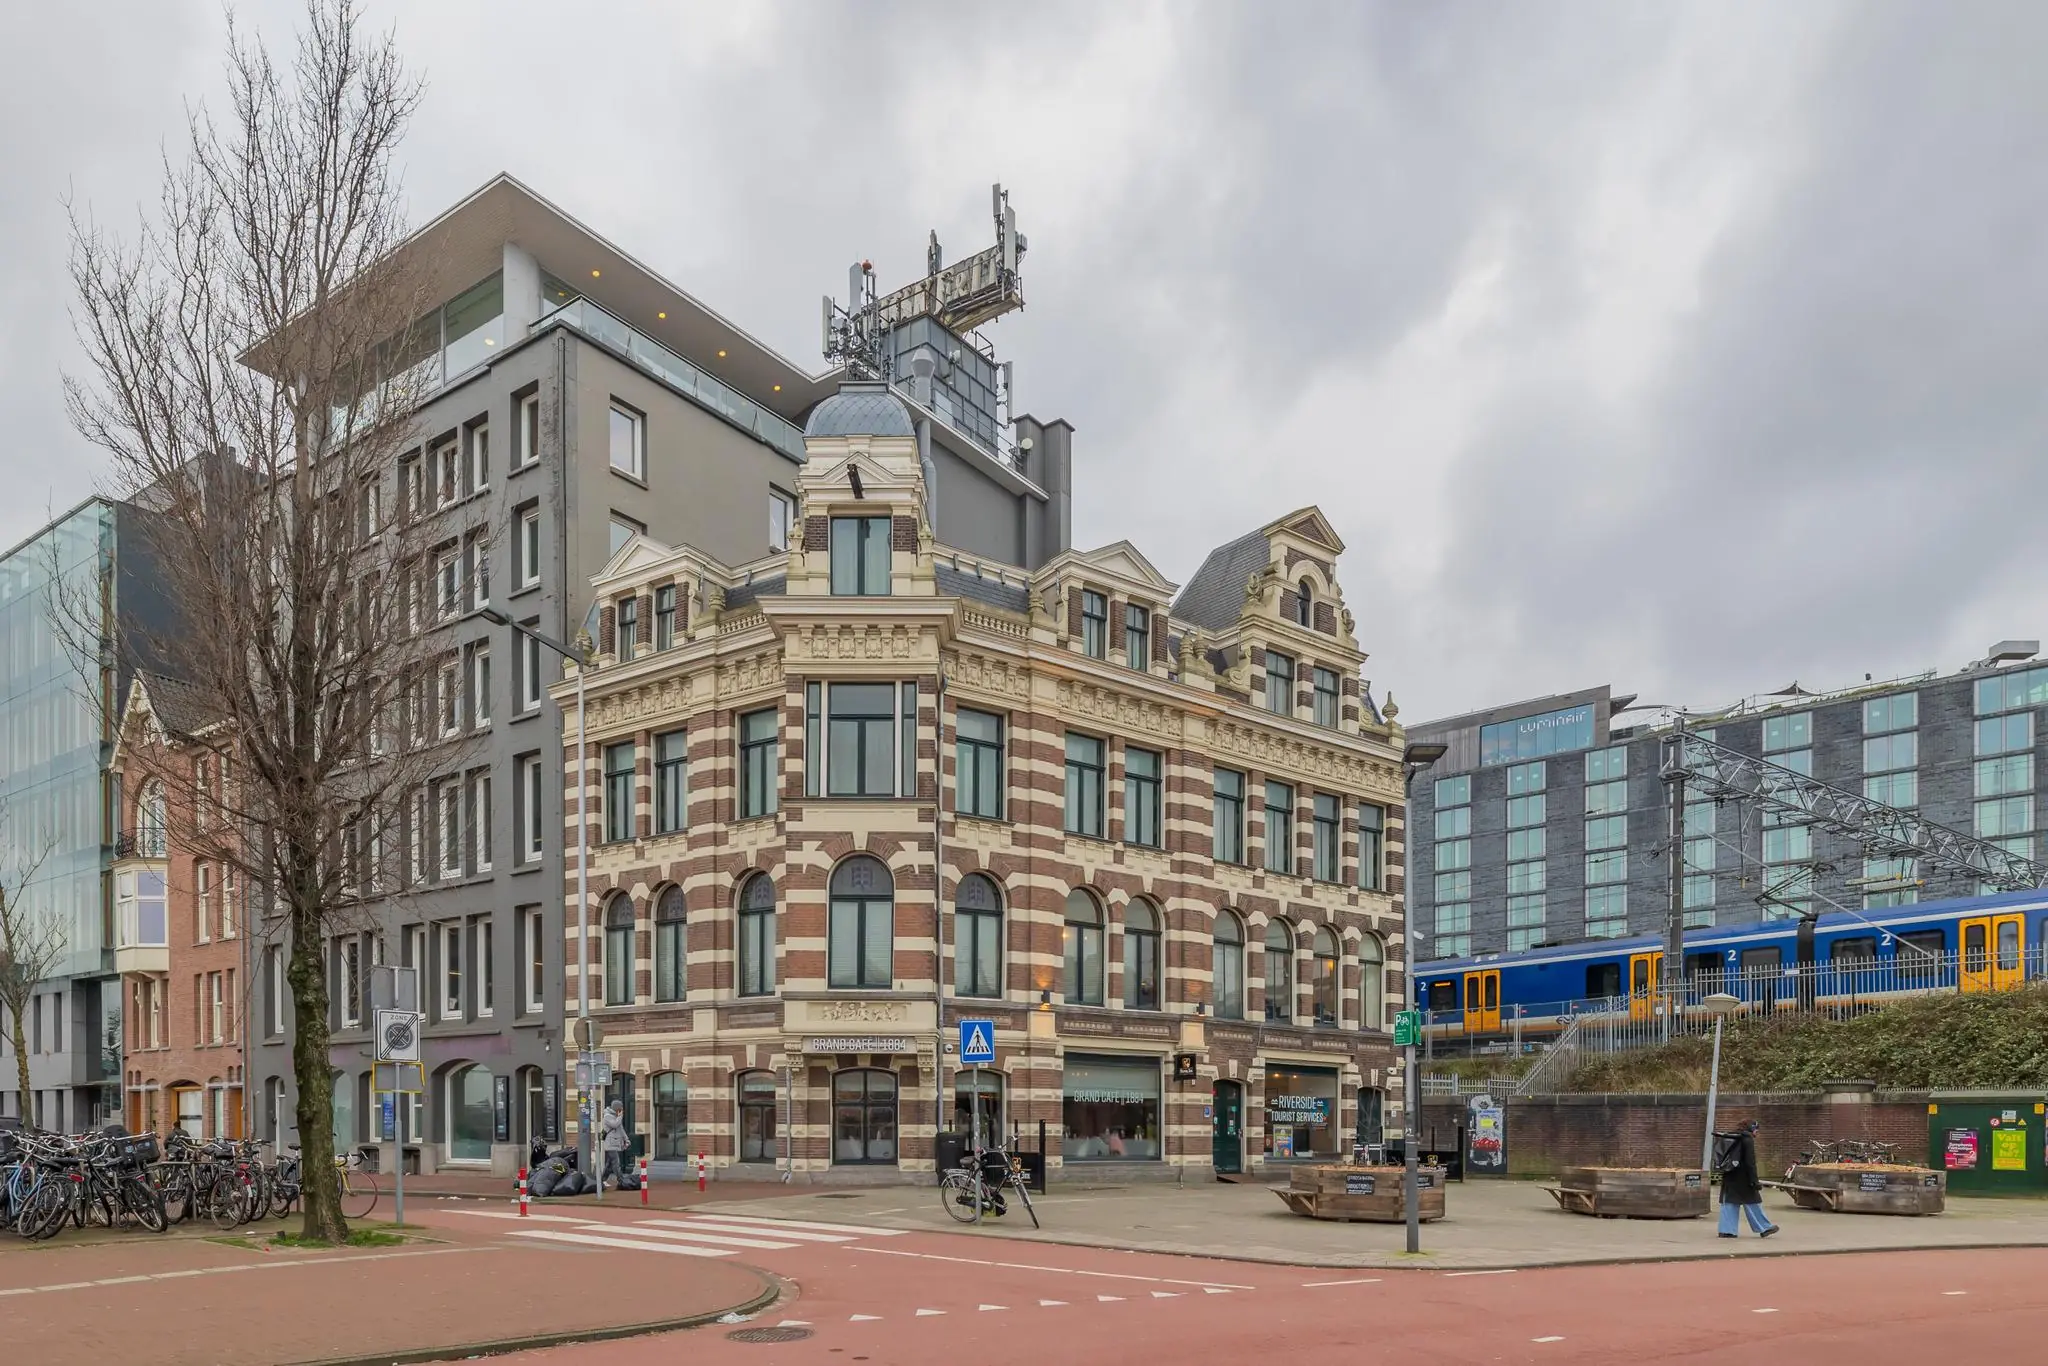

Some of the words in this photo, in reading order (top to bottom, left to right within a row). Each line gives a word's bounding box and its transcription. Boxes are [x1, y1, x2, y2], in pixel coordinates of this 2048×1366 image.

[1881, 934, 1891, 946] 2
[1728, 950, 1736, 961] 2
[1421, 982, 1427, 991] 2
[1396, 1014, 1401, 1026] P
[813, 1038, 846, 1050] GRAND
[883, 1038, 906, 1050] 1884
[1074, 1089, 1100, 1102] GRAND
[1126, 1091, 1144, 1104] 1884
[1278, 1095, 1317, 1109] RIVERSIDE
[1271, 1110, 1296, 1121] TOURIST
[1296, 1111, 1323, 1122] SERVICES
